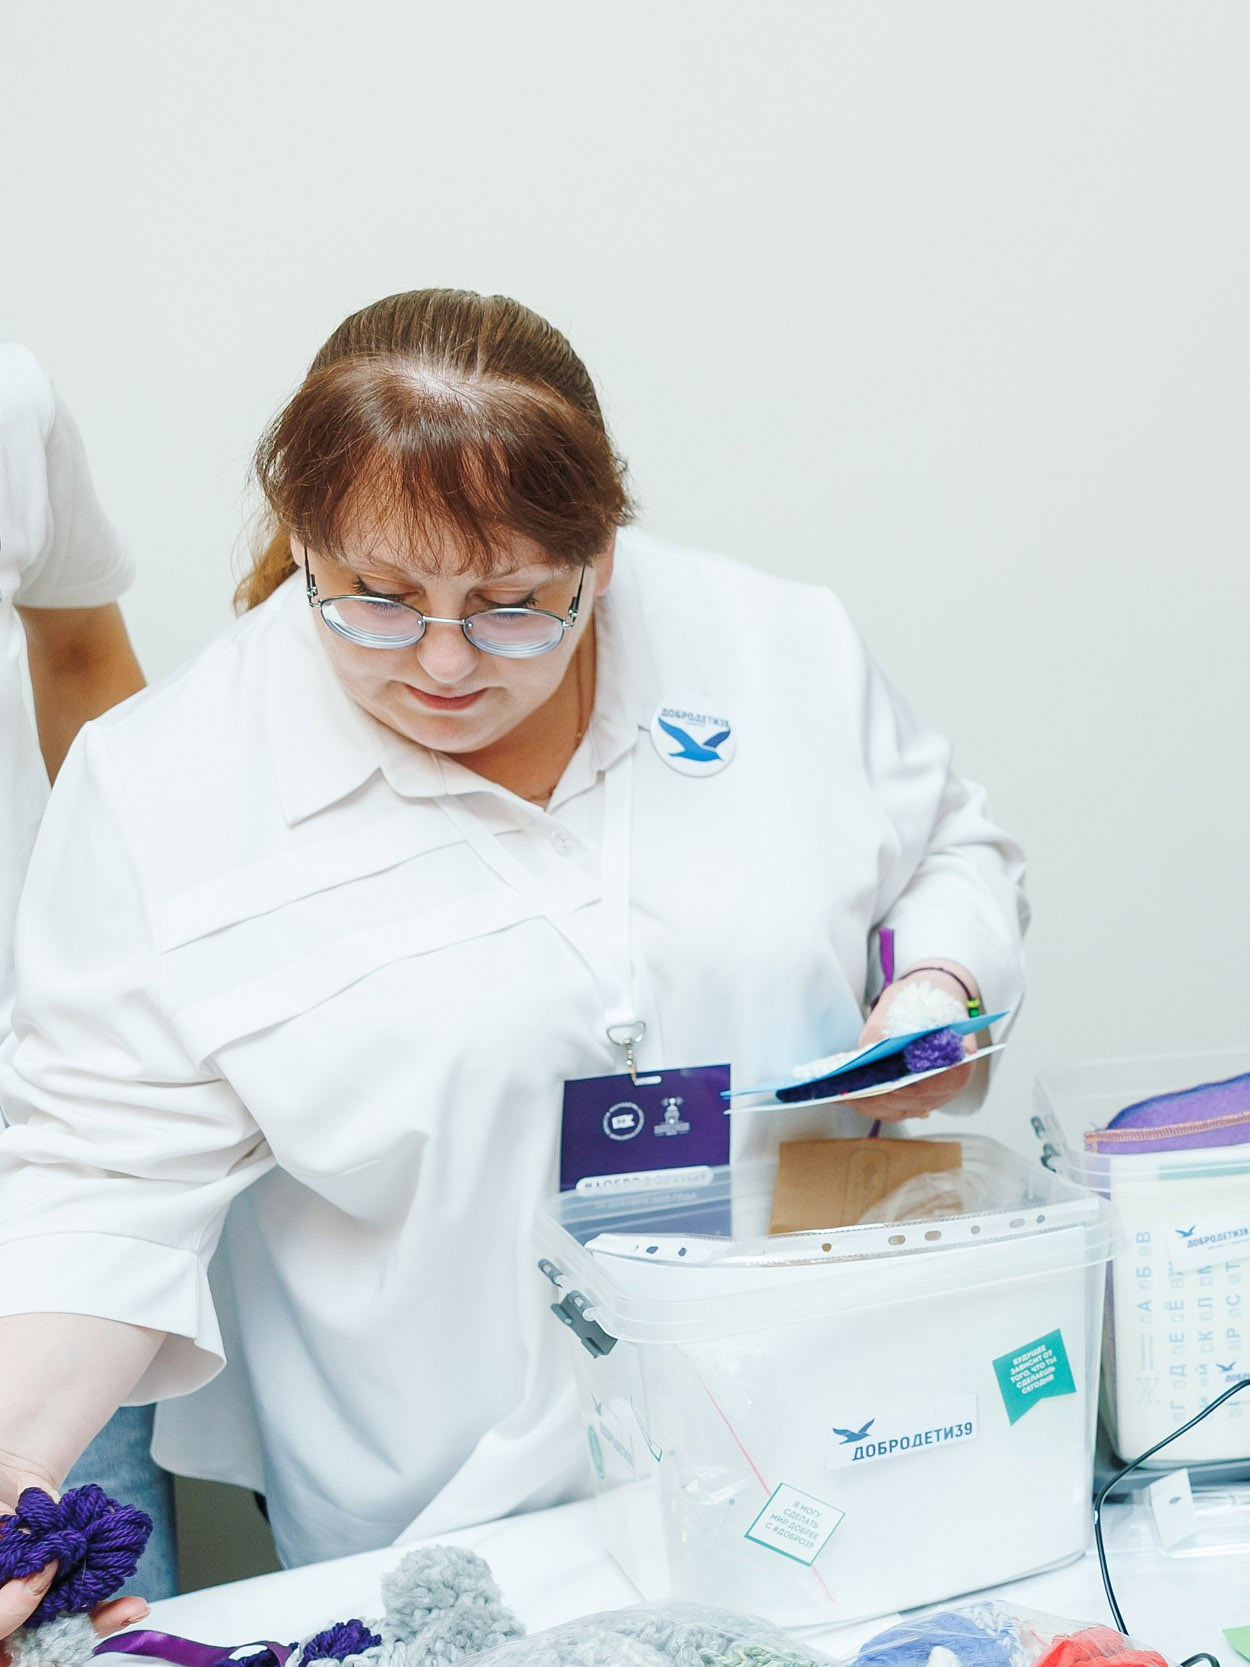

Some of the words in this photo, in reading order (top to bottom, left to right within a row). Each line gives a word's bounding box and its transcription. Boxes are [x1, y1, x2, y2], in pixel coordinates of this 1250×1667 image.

[852, 1422, 973, 1461] ДОБРОДЕТИ39
[783, 1508, 818, 1528] СДЕЛАТЬ
[800, 1504, 822, 1518] МОГУ
[770, 1513, 789, 1525] МИР
[787, 1522, 819, 1541] ДОБРЕЕ
